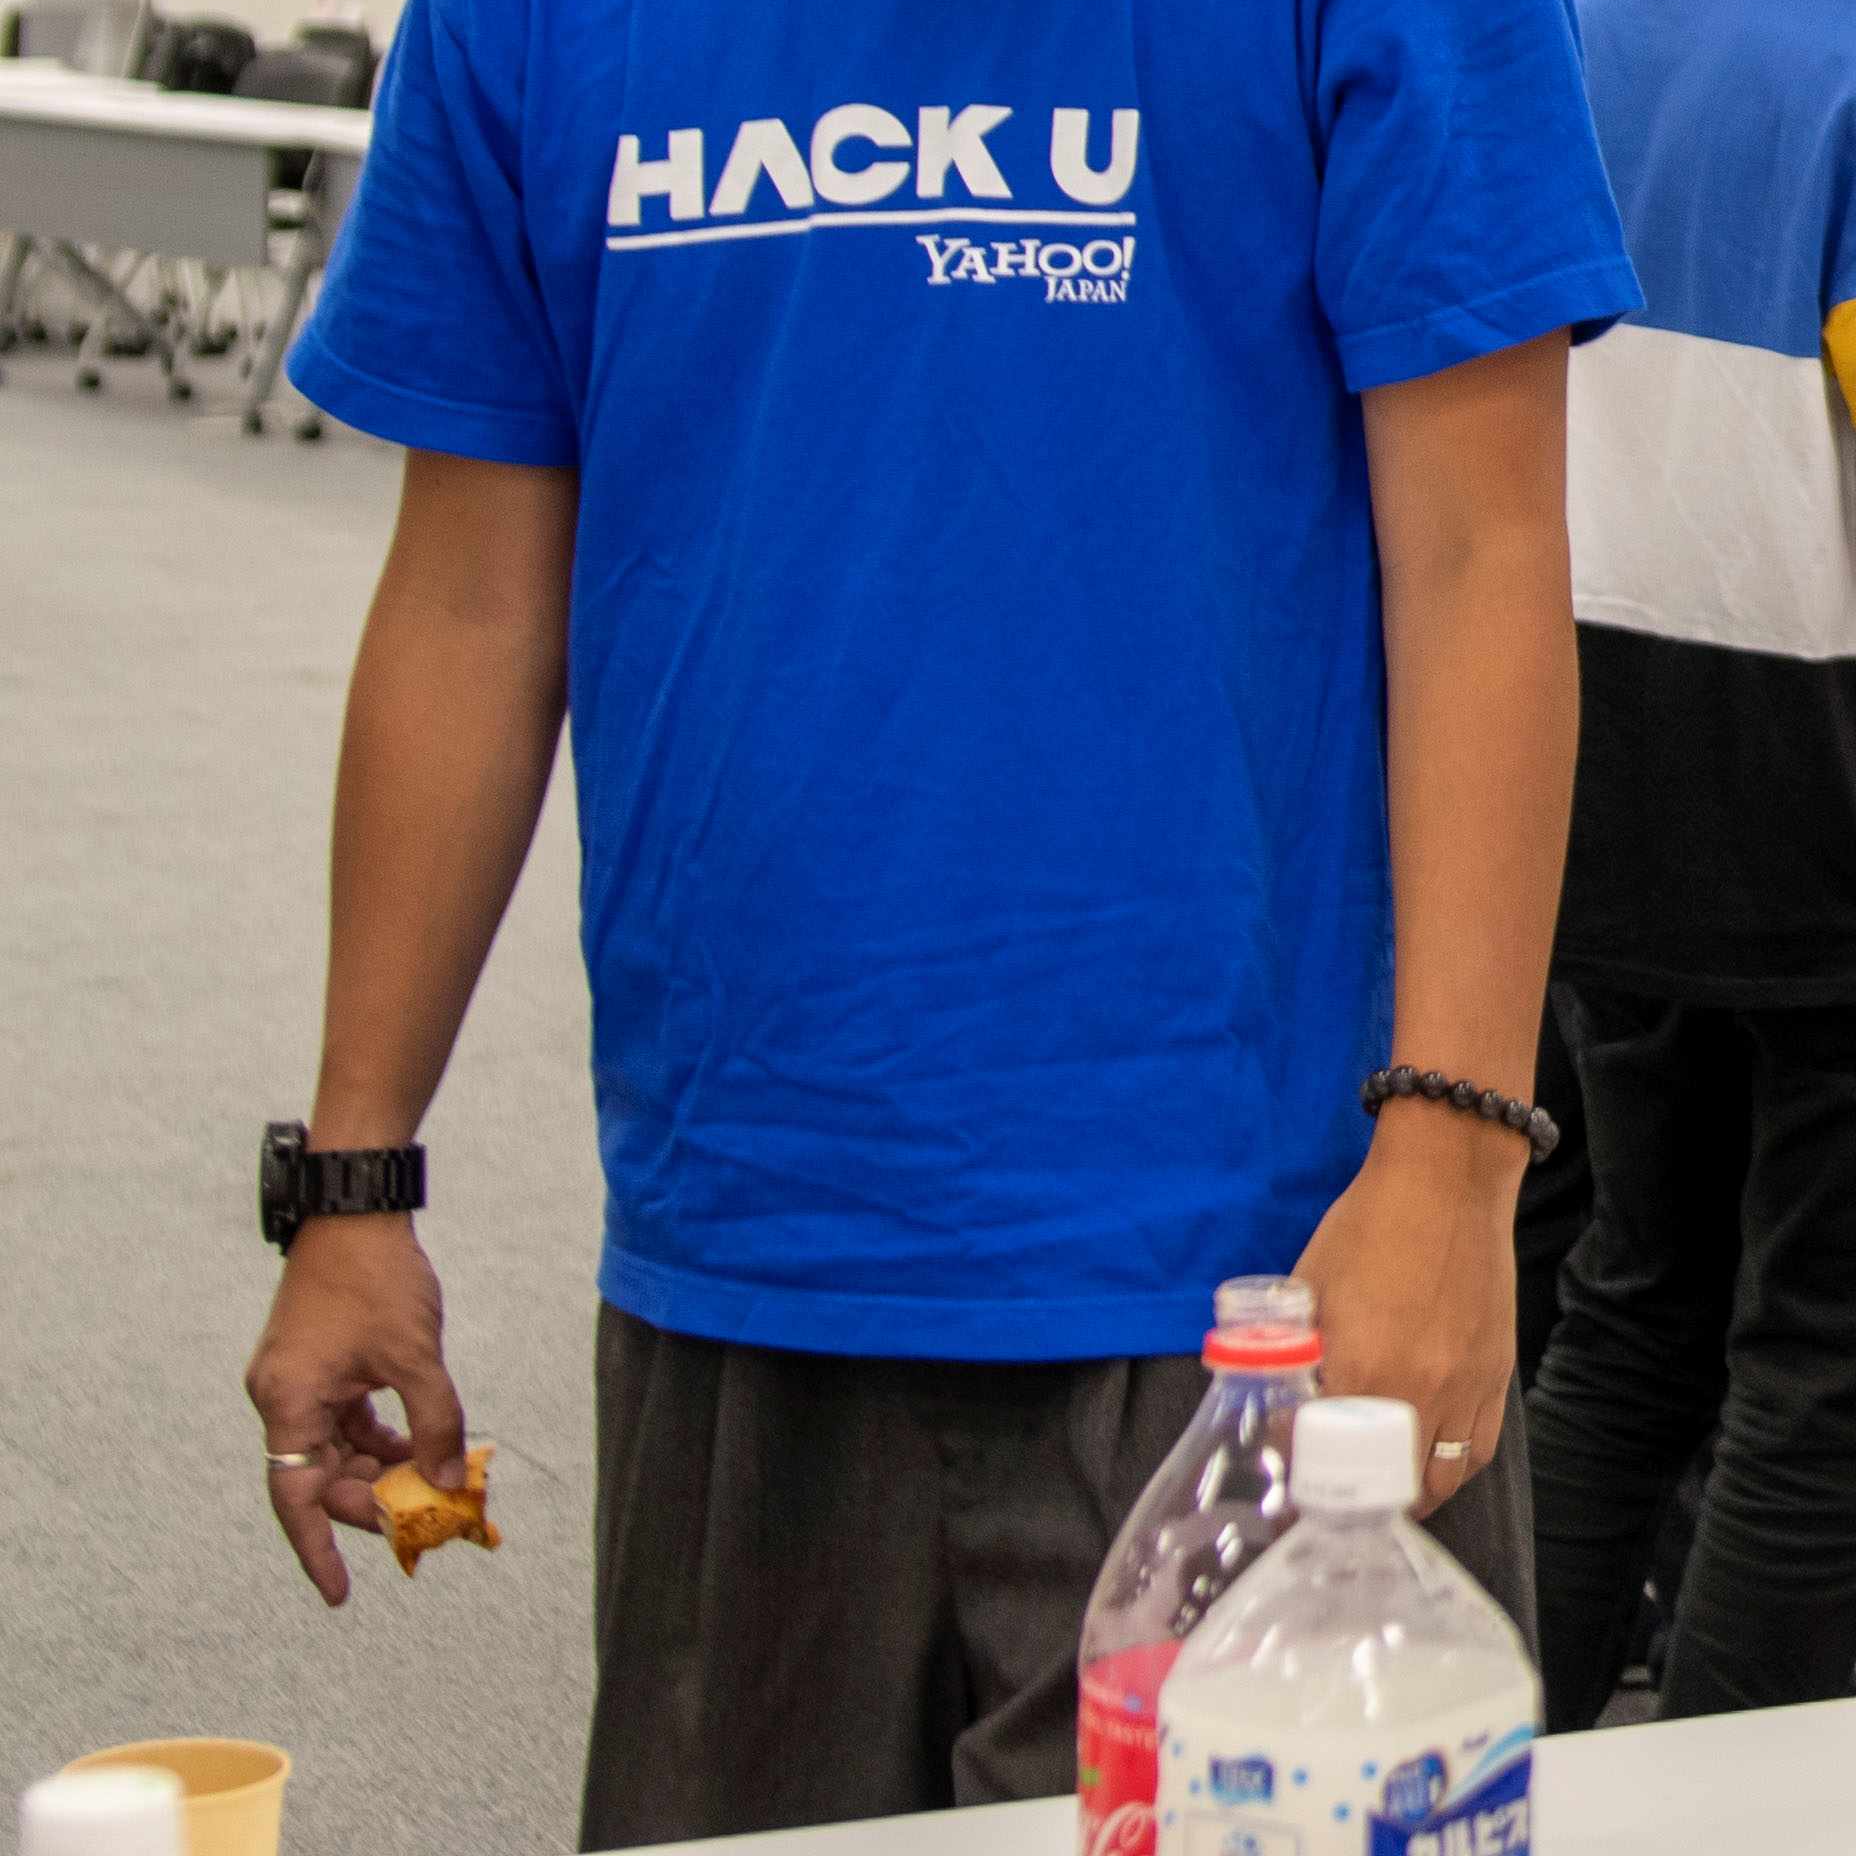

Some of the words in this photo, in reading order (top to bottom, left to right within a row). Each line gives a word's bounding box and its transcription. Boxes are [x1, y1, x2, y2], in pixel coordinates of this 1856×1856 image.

[606, 102, 1013, 226] HACK
[1050, 107, 1140, 206] U
[915, 234, 1136, 285] YAHOO!
[1044, 275, 1128, 304] JAPAN
